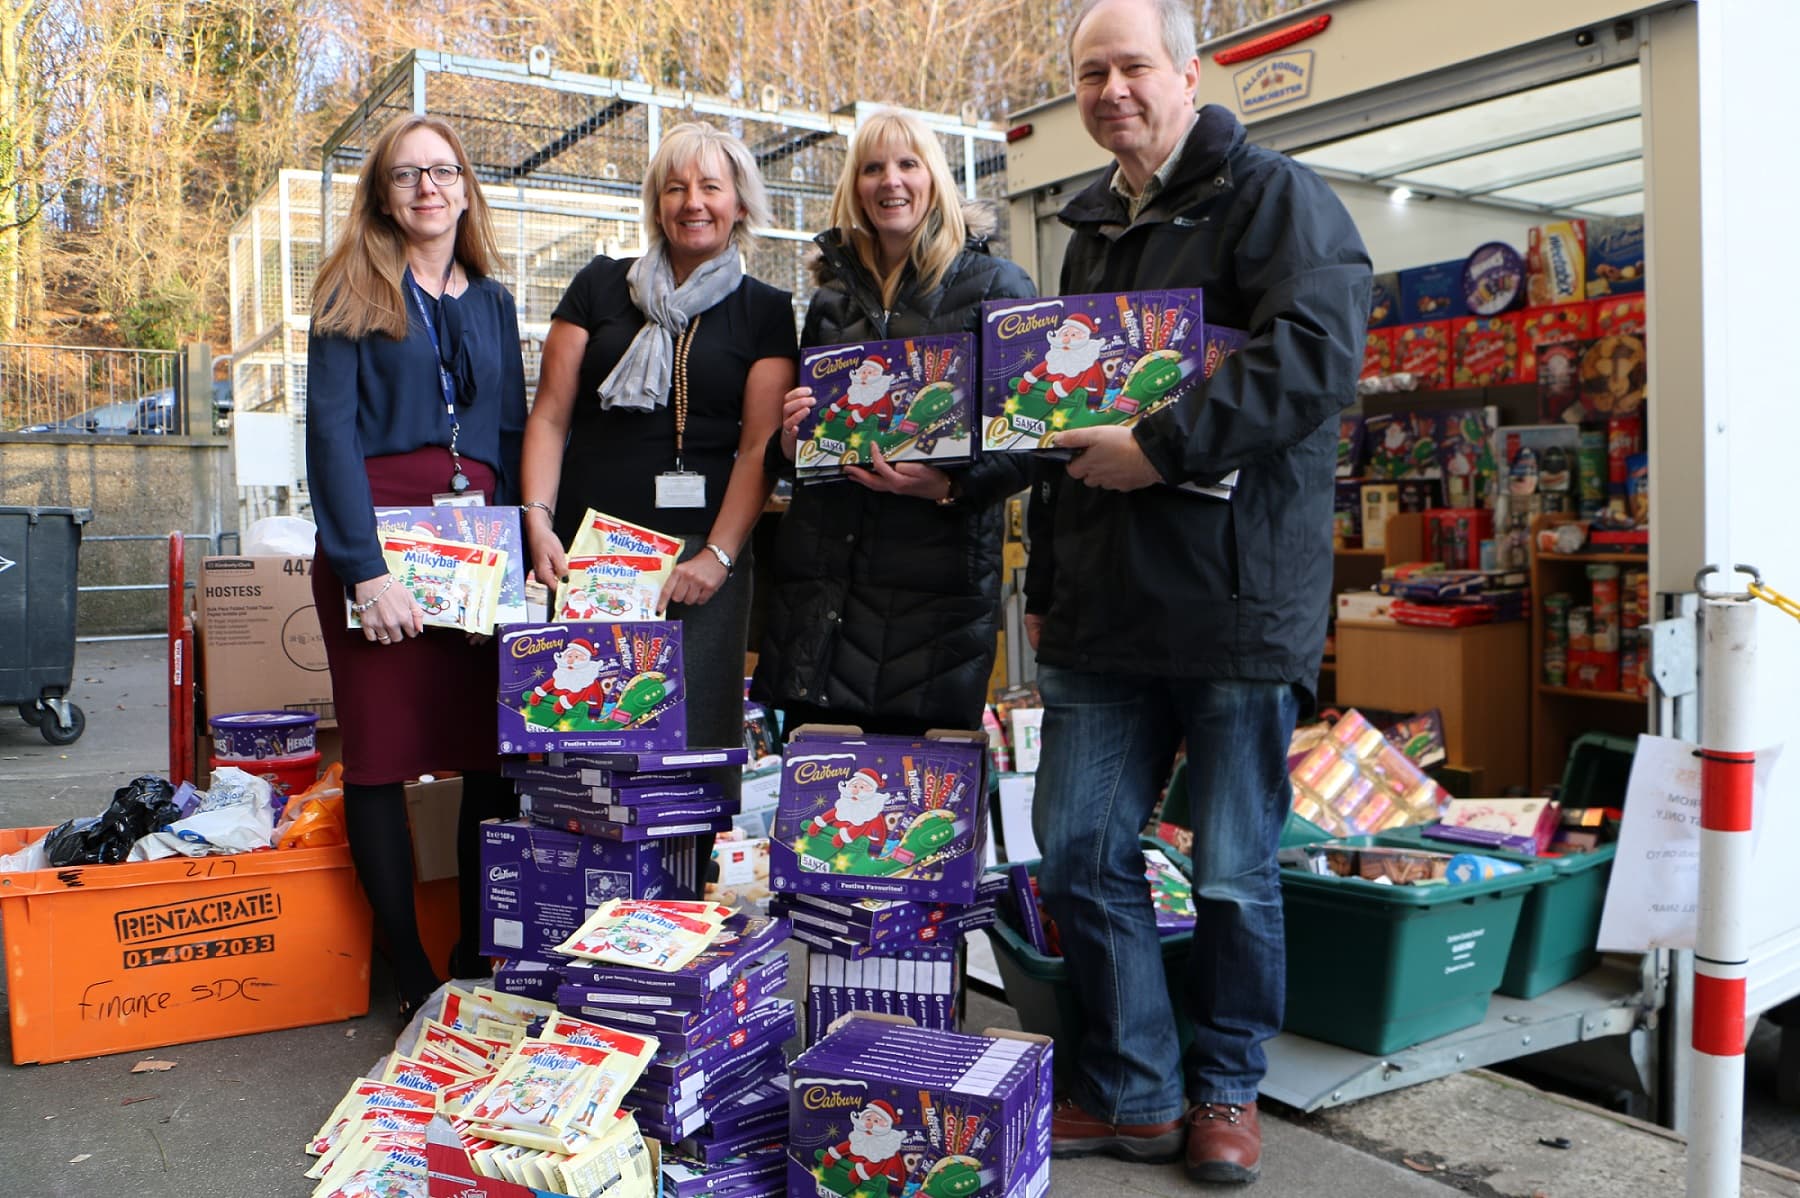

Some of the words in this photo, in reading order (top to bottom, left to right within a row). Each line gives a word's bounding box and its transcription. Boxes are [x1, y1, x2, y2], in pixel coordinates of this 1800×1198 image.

[997, 313, 1059, 340] Cadbury
[812, 356, 860, 379] Cadbury
[607, 532, 657, 555] Milkybar
[404, 551, 460, 569] Milkybar
[586, 565, 640, 578] Milkybar
[206, 585, 262, 598] HOSTESS
[511, 636, 565, 659] Cadbury
[794, 761, 851, 785] Cadbury
[489, 866, 519, 882] Cadbury
[120, 893, 274, 940] RENTACRATE
[125, 943, 208, 969] 01-403
[215, 935, 274, 956] 2033
[529, 1053, 582, 1070] Milkybar
[803, 1085, 862, 1110] Cadbury
[388, 1151, 428, 1168] Milky
